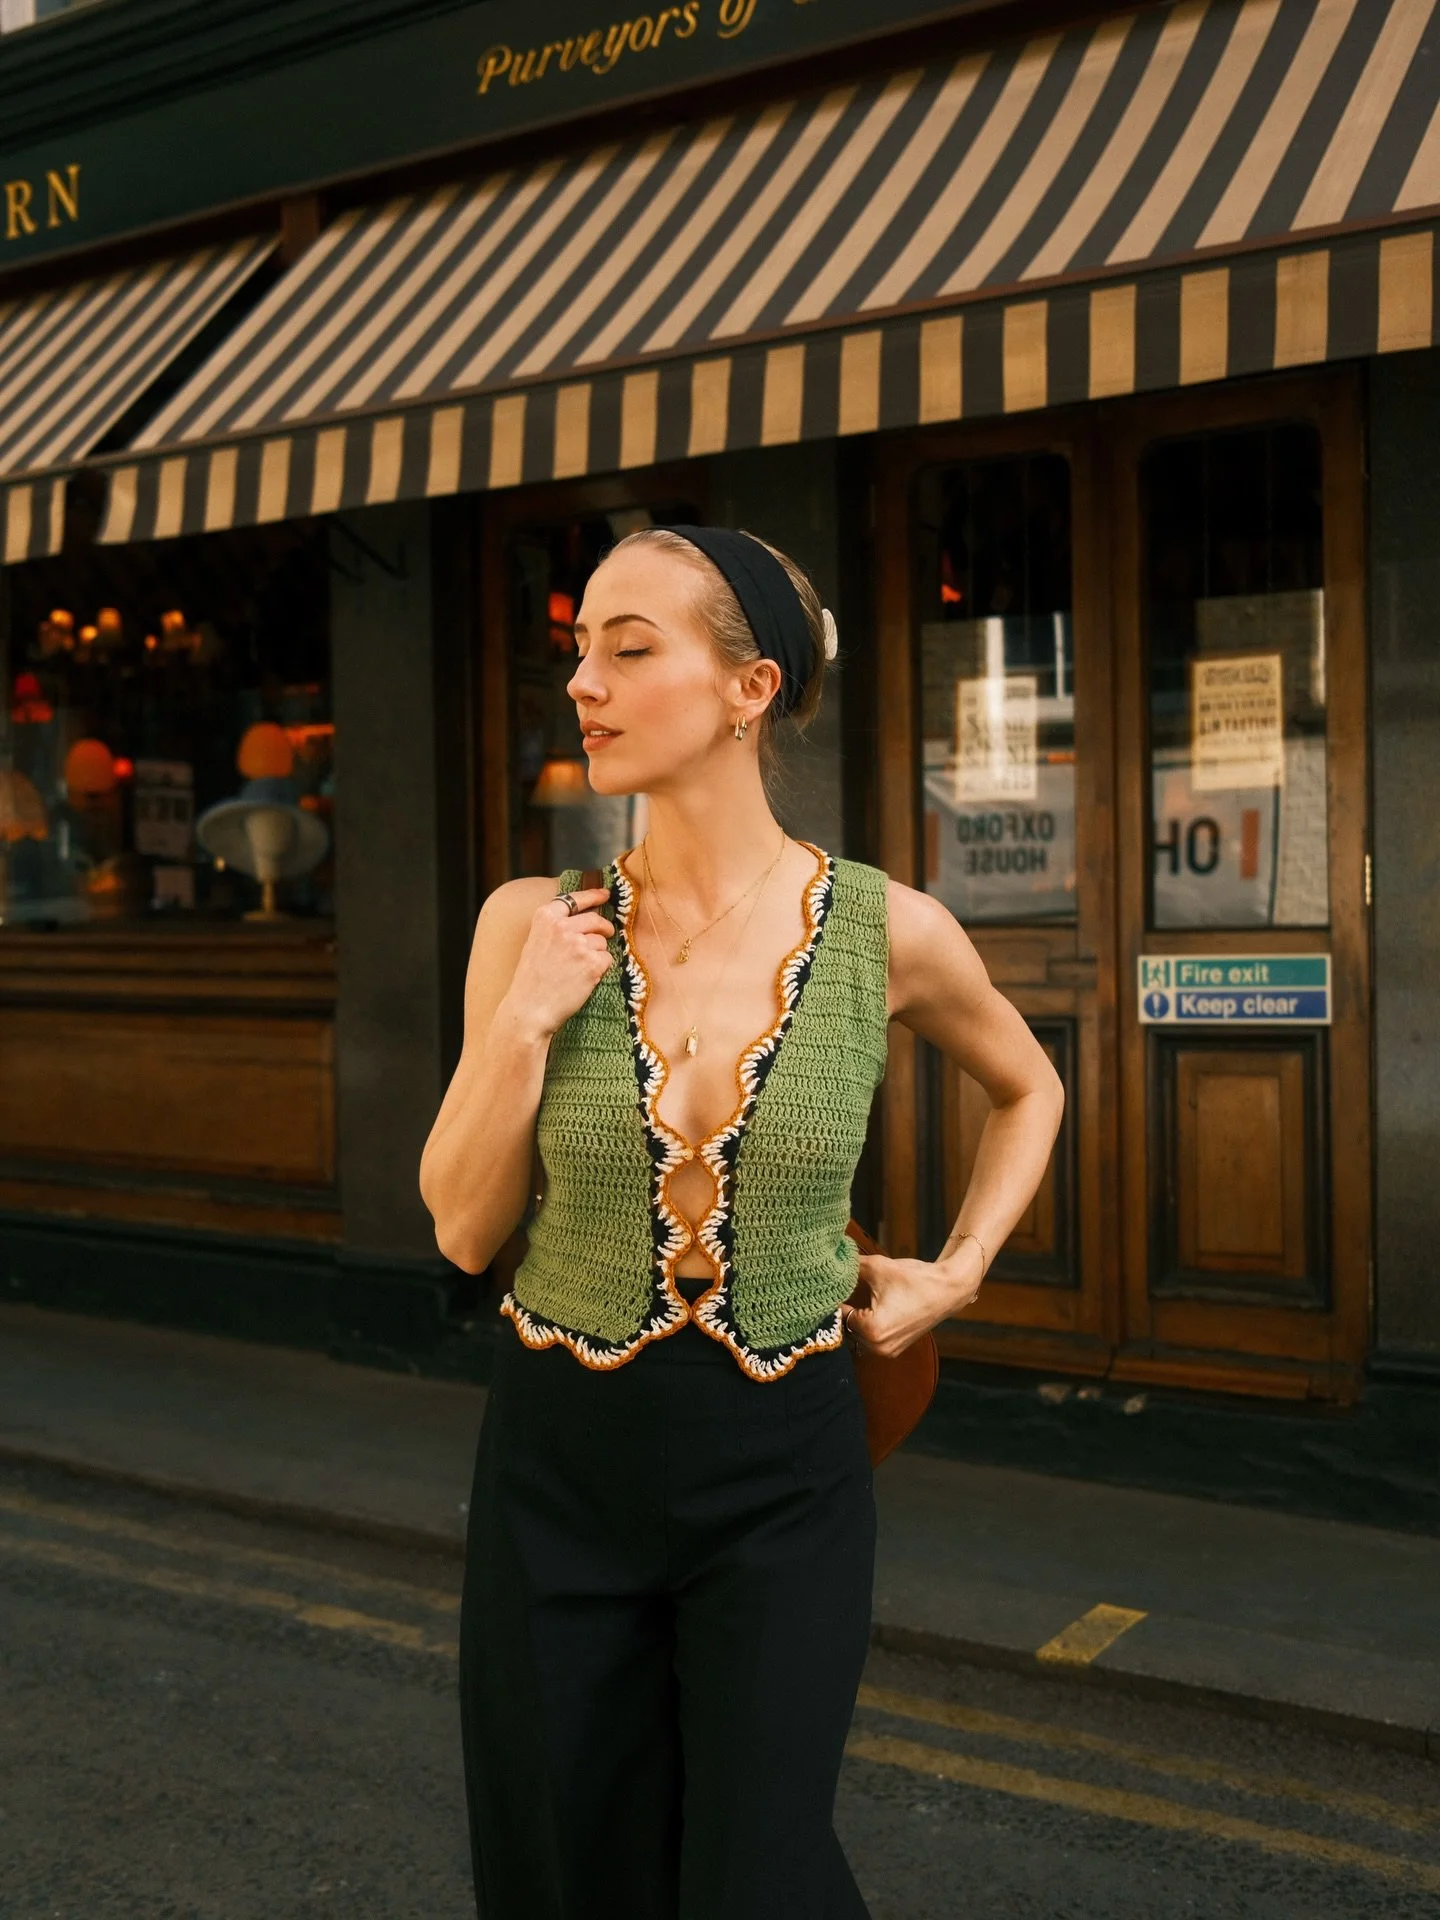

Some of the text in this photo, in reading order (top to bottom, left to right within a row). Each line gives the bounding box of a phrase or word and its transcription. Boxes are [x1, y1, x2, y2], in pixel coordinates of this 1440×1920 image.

[477, 1, 700, 94] Purveyors
[1181, 963, 1269, 984] Fire exit
[1181, 994, 1299, 1018] Keep clear
